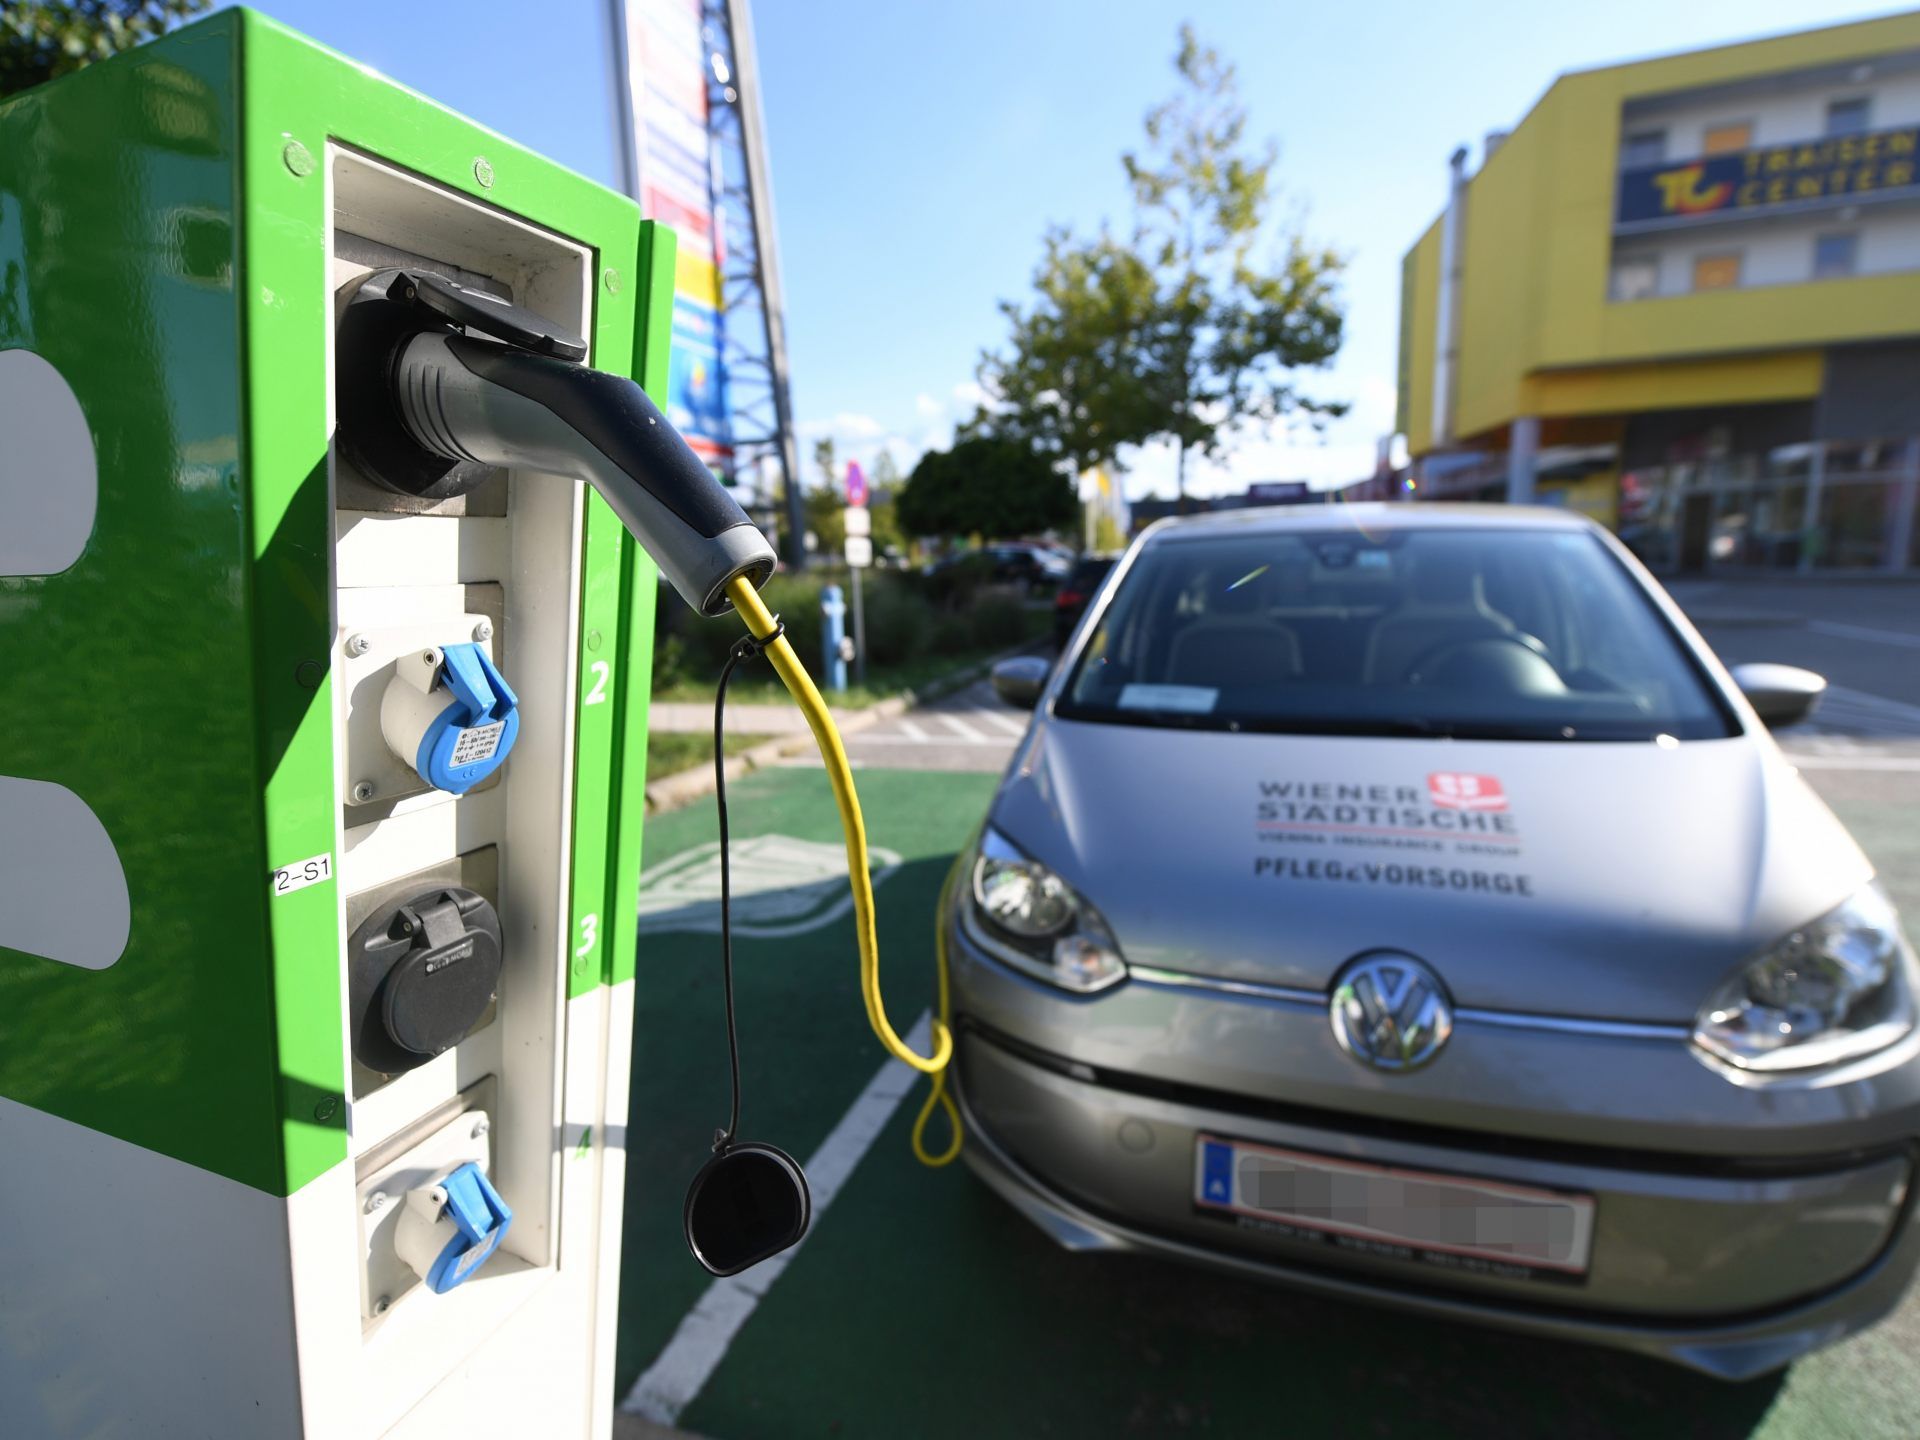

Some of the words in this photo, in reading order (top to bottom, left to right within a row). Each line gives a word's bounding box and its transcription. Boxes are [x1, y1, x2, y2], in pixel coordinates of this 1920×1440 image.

[1743, 128, 1918, 176] TRAISEN
[1737, 160, 1914, 206] CENTER
[585, 660, 609, 706] 2
[1258, 780, 1420, 805] WIENER
[277, 857, 329, 891] 2-S1
[575, 912, 598, 957] 3
